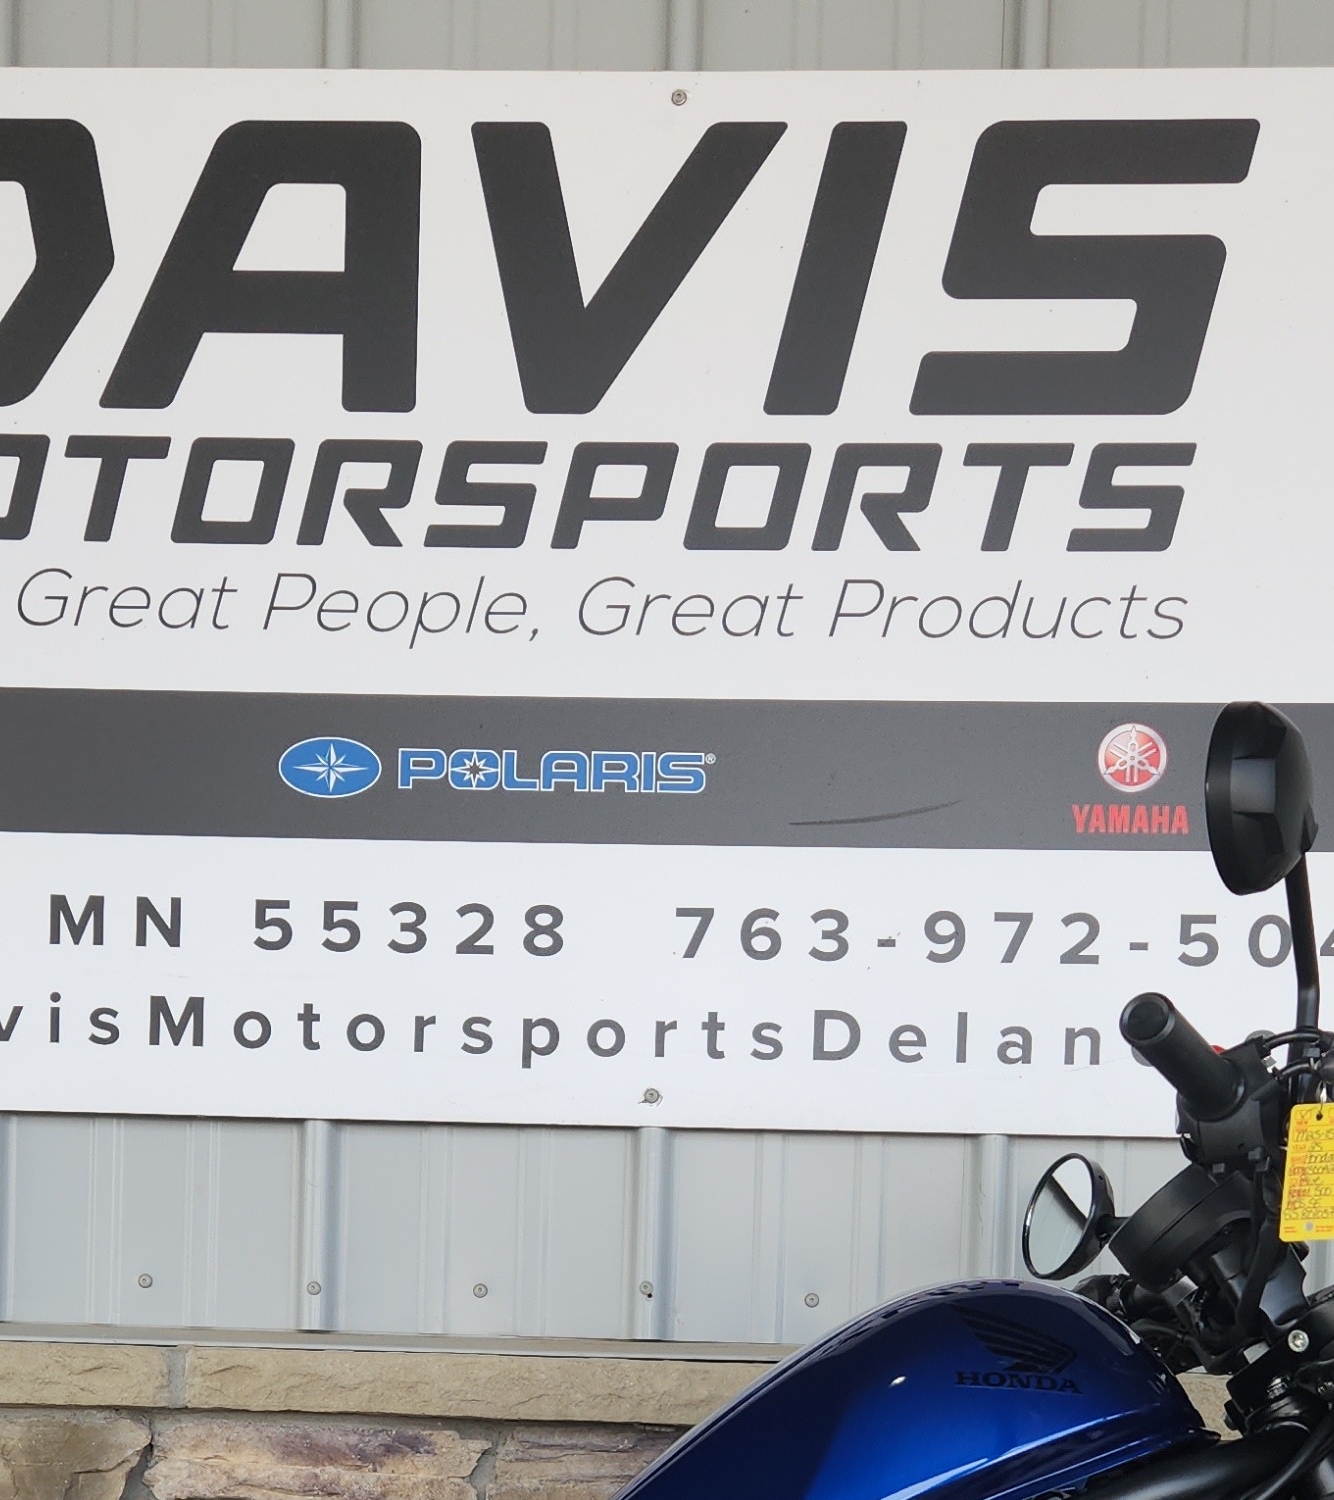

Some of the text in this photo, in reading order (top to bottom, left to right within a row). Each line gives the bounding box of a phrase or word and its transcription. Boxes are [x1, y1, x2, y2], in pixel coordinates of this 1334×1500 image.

[17, 567, 1188, 650] Great People, Great Products
[1071, 803, 1189, 835] YAMAHA
[49, 894, 182, 948] MN
[253, 899, 564, 957] 55328
[954, 1370, 1084, 1395] HONDA
